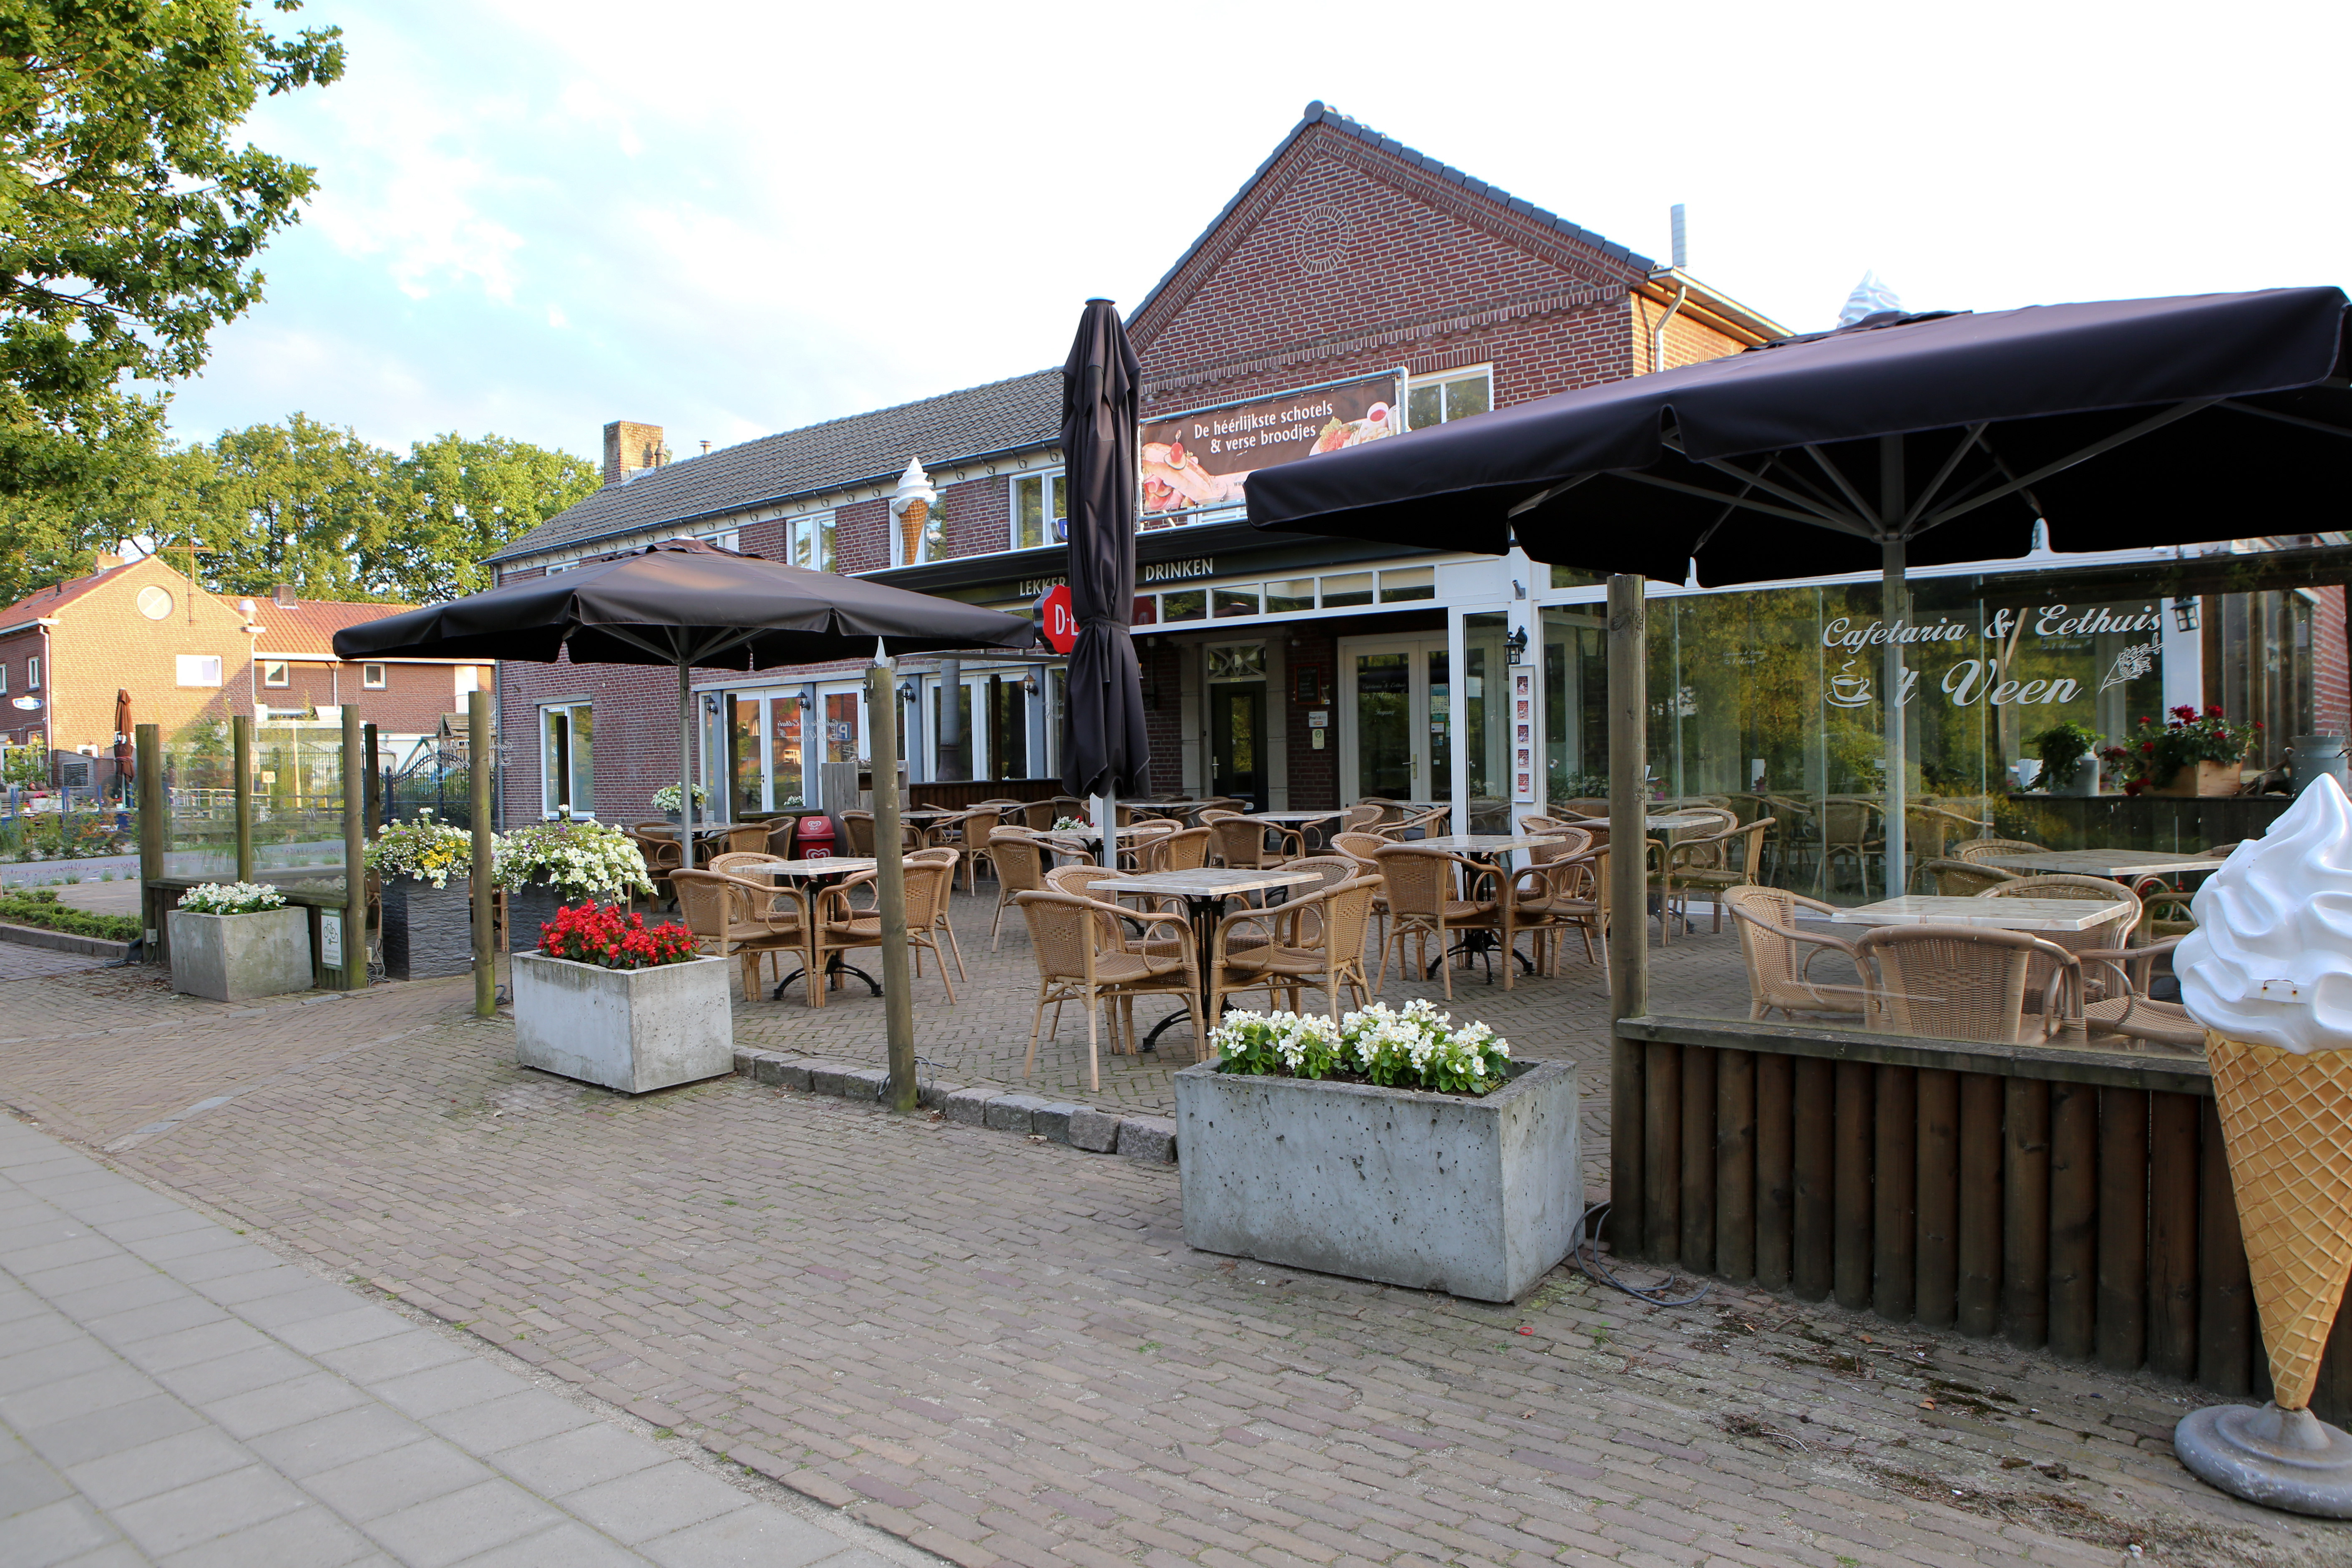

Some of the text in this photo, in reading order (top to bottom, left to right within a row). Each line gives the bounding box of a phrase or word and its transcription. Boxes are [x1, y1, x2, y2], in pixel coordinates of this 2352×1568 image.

[1194, 400, 1333, 439] De héérlijkste schotels
[1210, 424, 1316, 453] & verse broodjes
[1145, 558, 1213, 581] DRINKEN
[1823, 604, 2162, 654] Cafetaria & Eethuis
[1941, 659, 2083, 706] Veen
